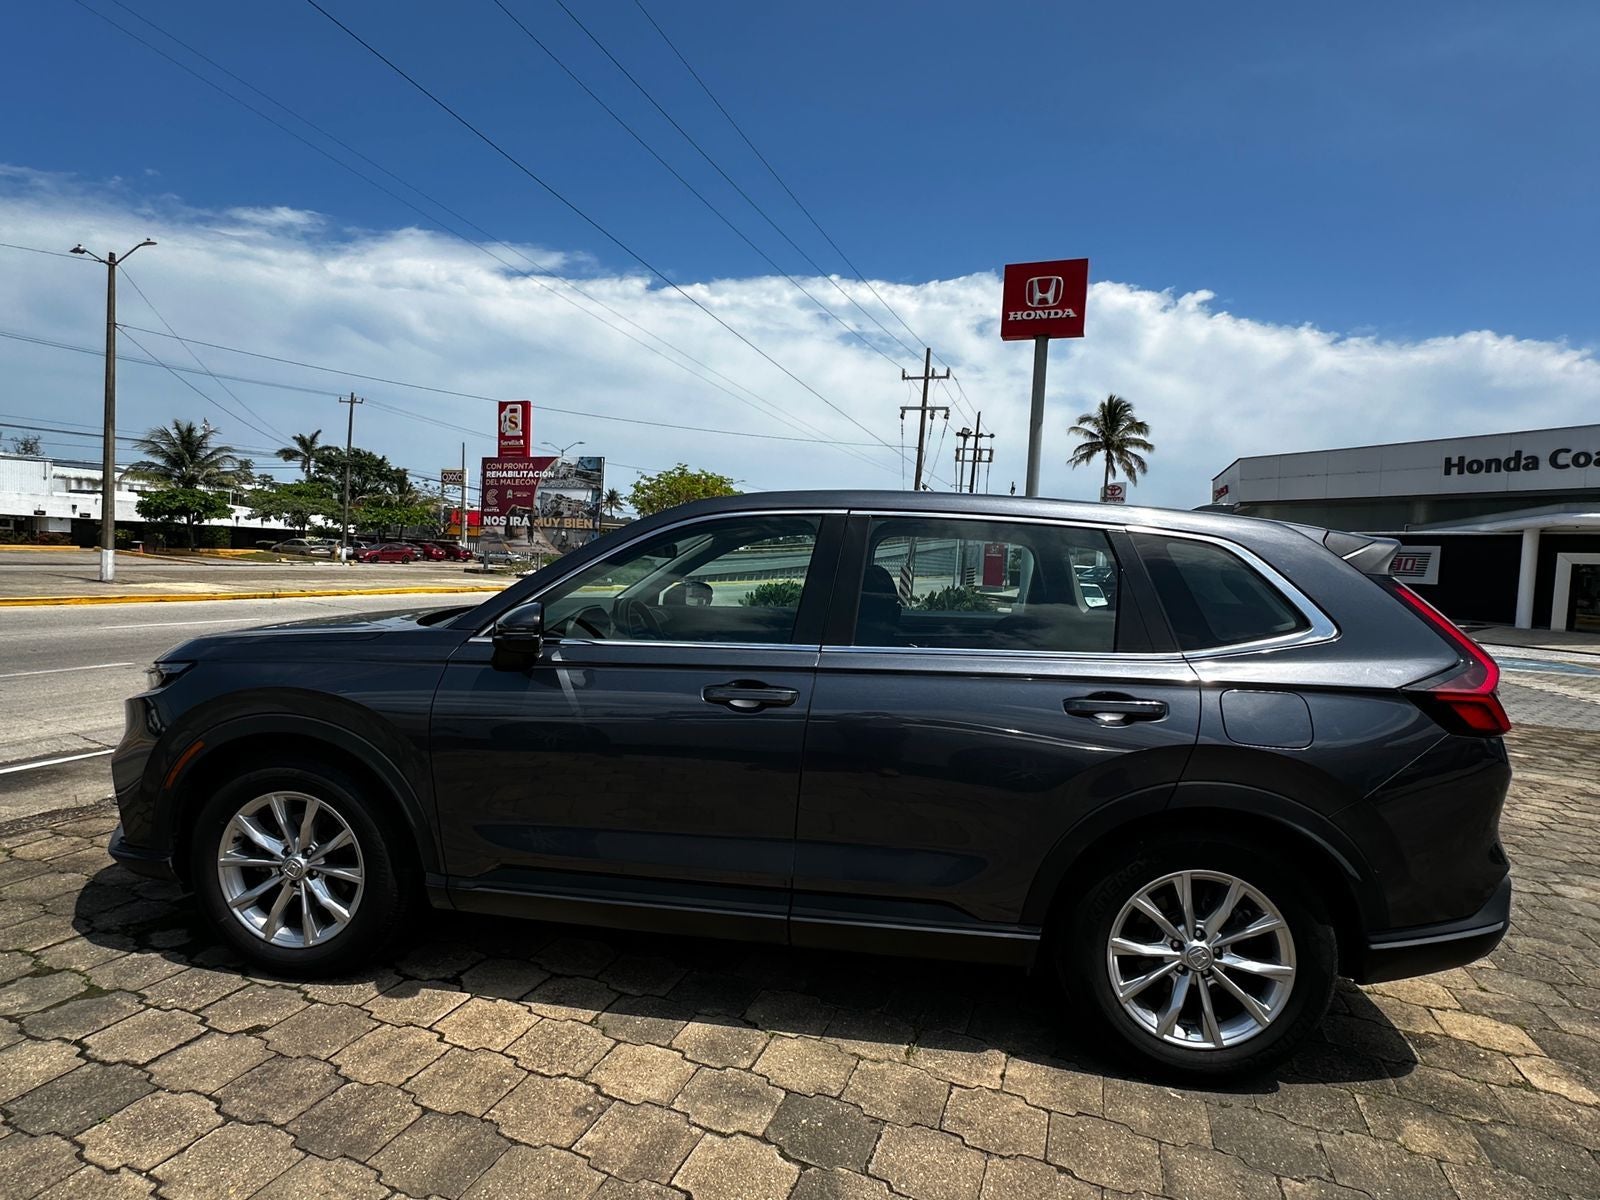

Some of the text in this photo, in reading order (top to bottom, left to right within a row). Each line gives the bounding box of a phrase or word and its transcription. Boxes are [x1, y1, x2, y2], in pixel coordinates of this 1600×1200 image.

[1008, 308, 1077, 321] HONDA
[503, 462, 534, 470] PRONTA
[1443, 450, 1540, 476] Honda
[486, 470, 555, 478] REHABILITACIÓN
[485, 478, 537, 486] DEL MALECÓN
[483, 513, 594, 529] NOS IRÁ MUY BIEN
